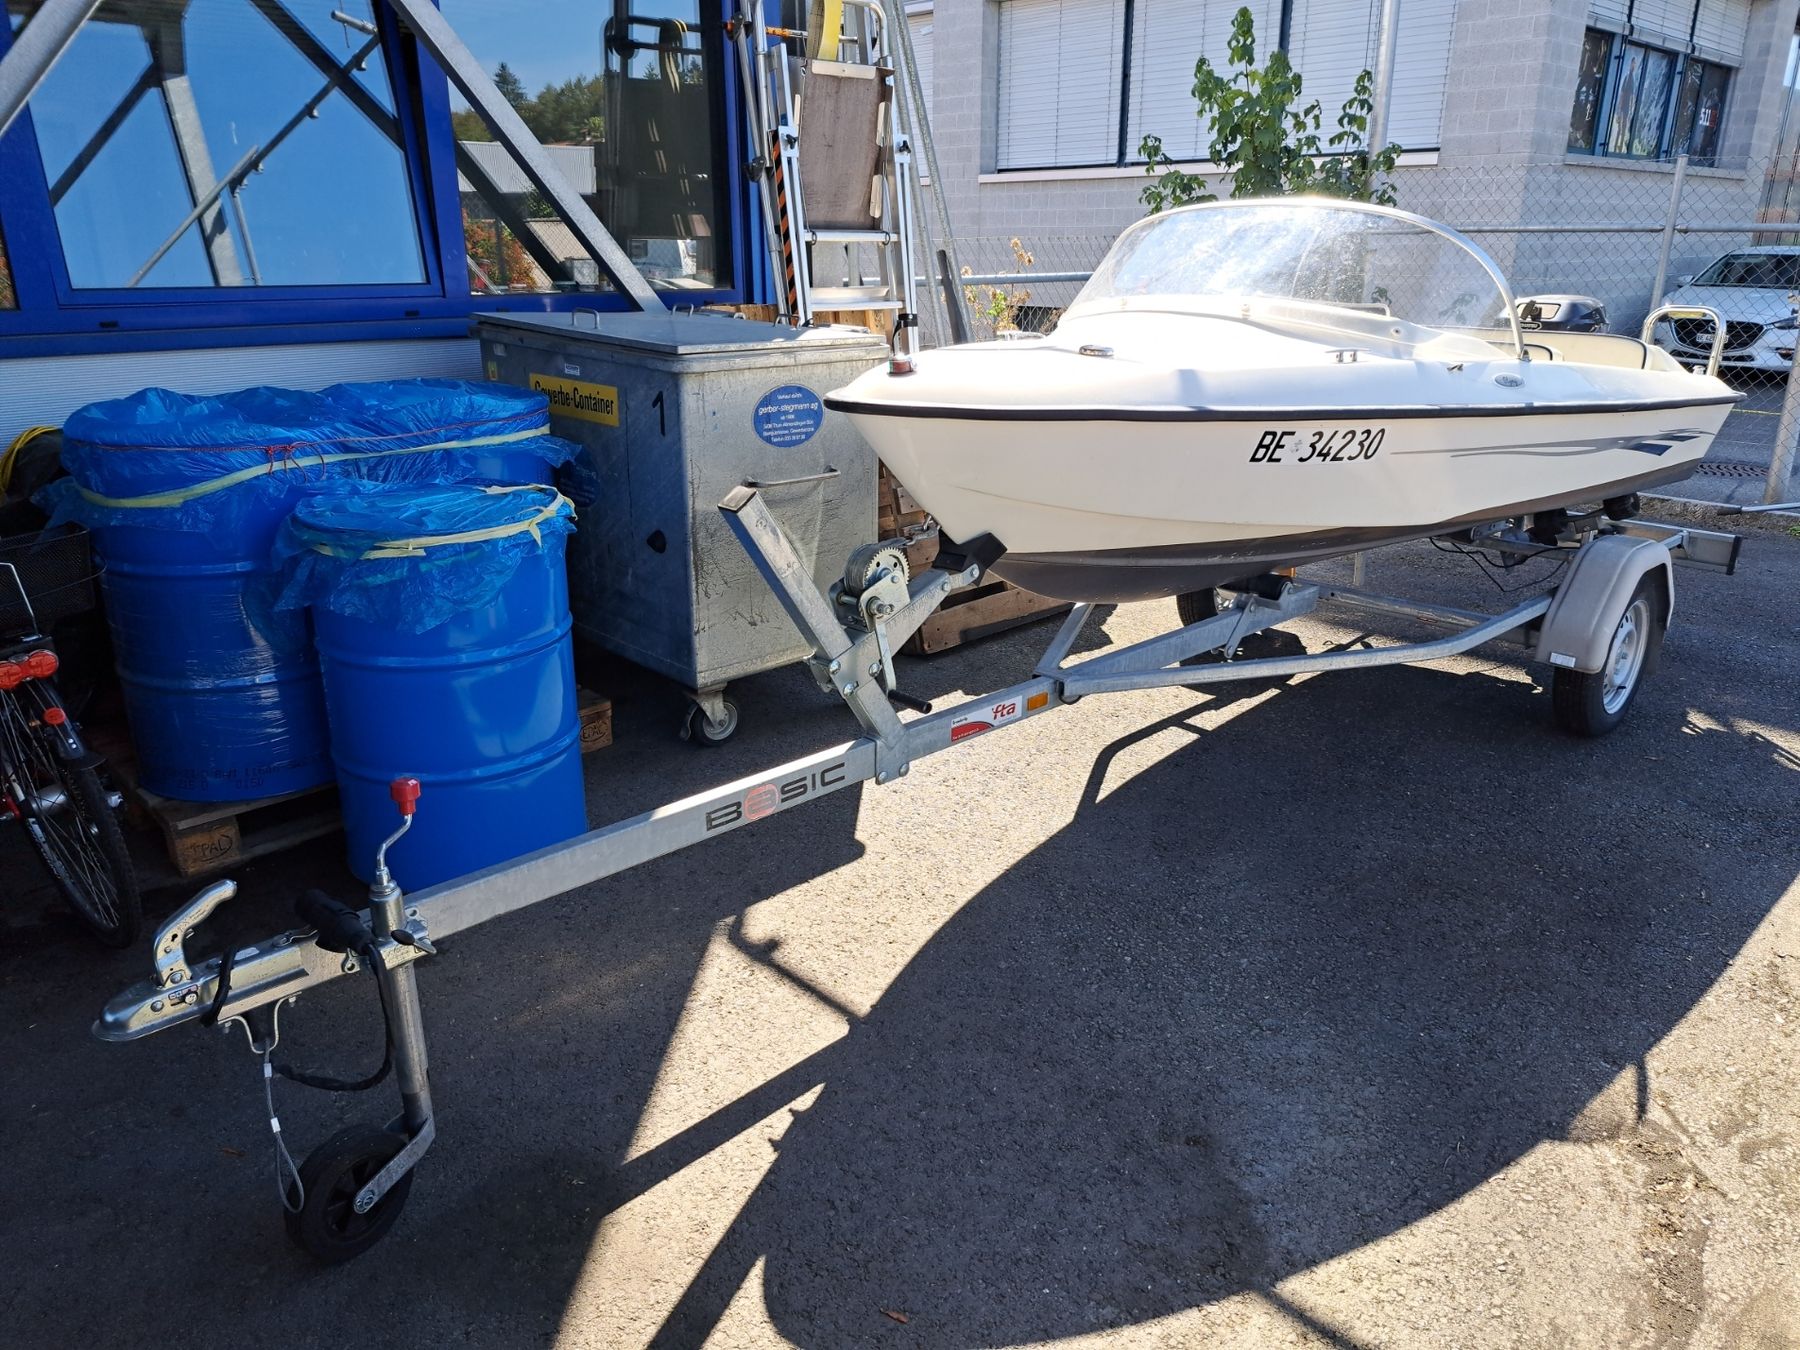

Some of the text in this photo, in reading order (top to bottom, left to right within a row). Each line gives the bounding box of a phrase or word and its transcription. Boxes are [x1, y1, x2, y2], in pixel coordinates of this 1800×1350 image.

[652, 390, 666, 437] 1
[1249, 428, 1386, 463] BE 34230
[992, 702, 1016, 721] fta
